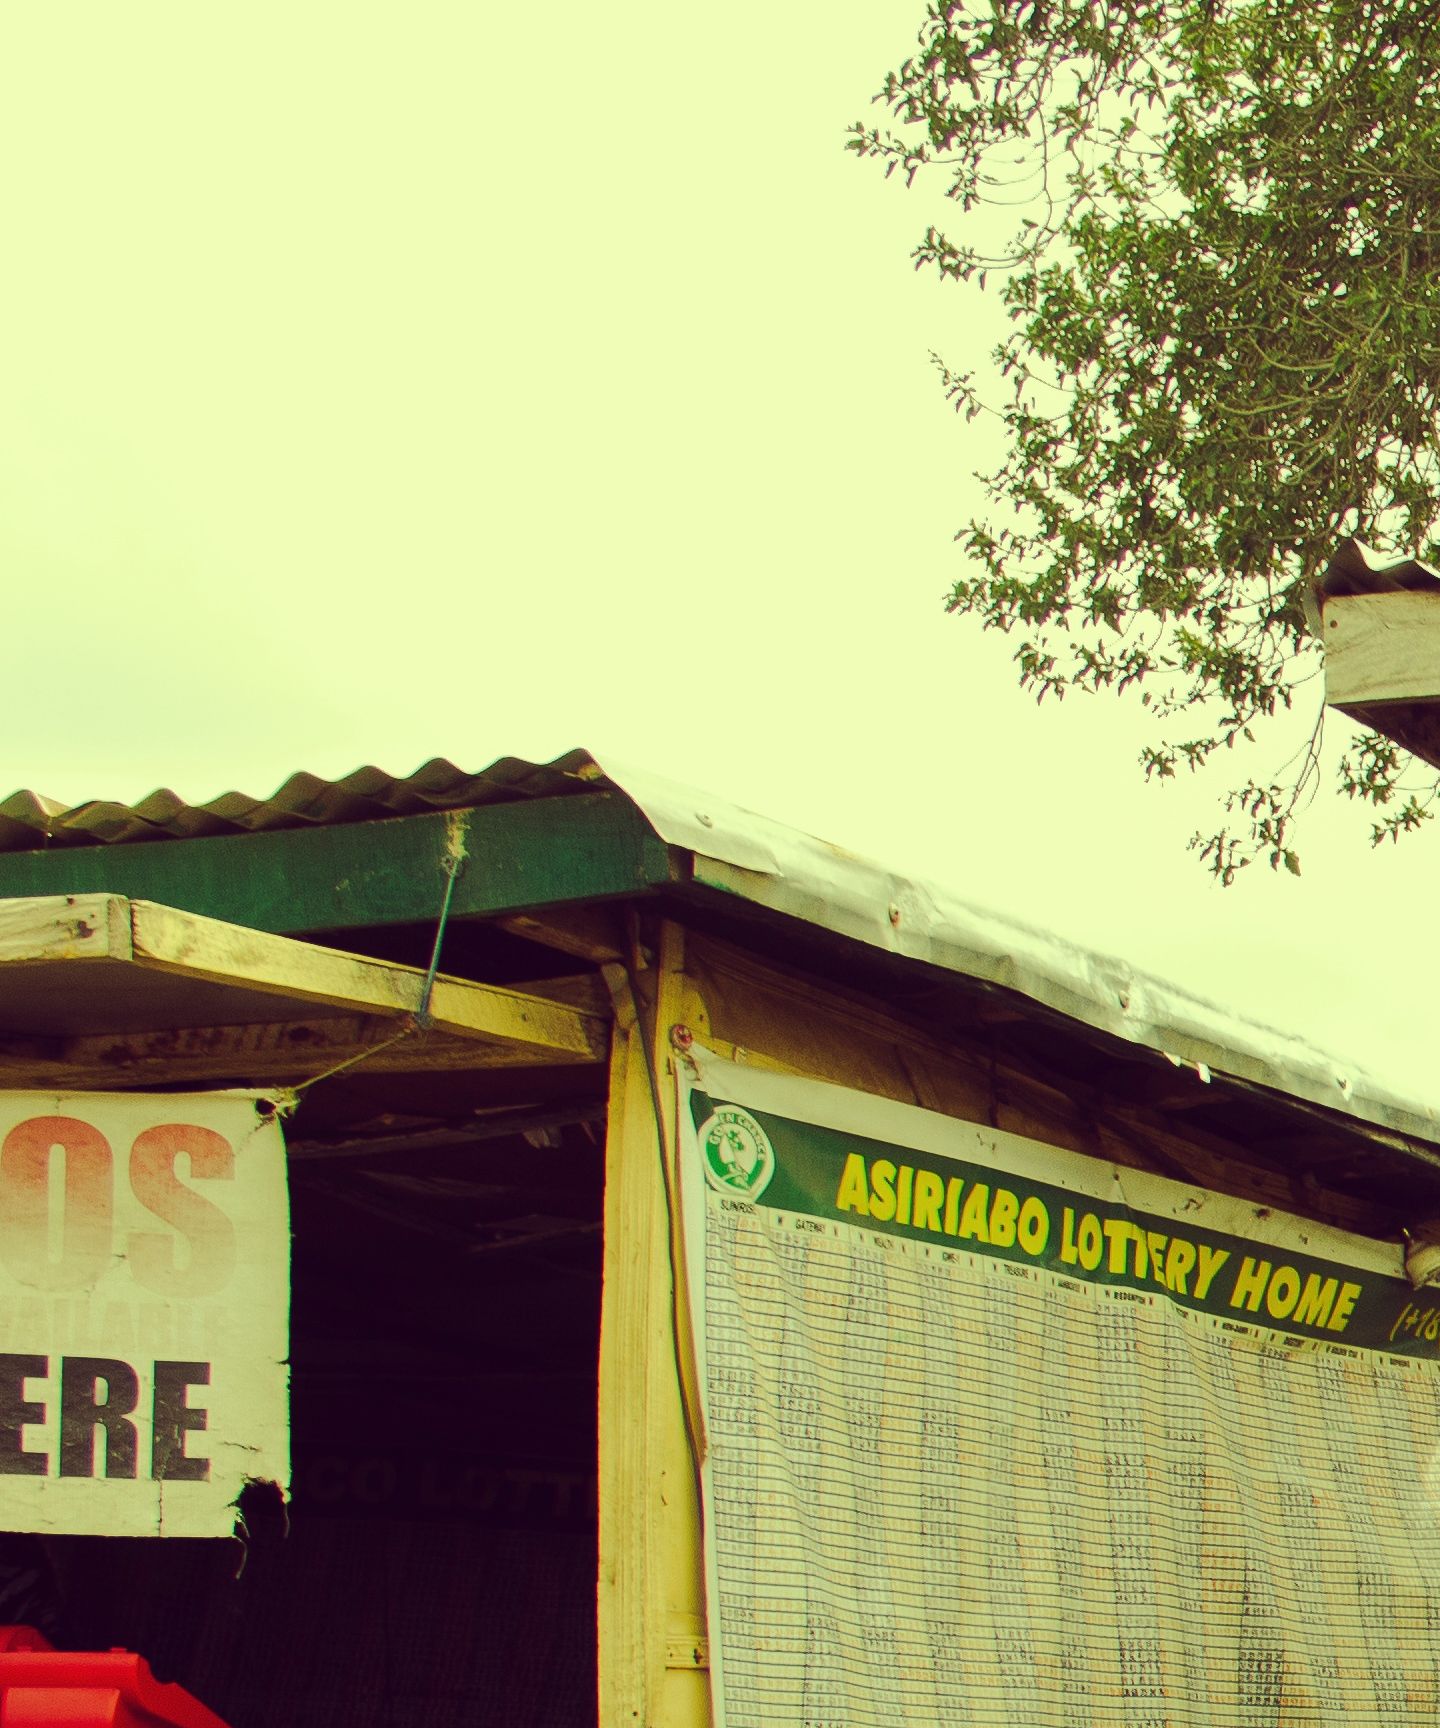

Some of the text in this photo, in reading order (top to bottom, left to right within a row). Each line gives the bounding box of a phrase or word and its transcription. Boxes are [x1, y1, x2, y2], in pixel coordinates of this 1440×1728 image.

[838, 1153, 1049, 1256] ASIRIABO
[1060, 1206, 1231, 1300] LOTTERY
[1230, 1256, 1362, 1332] HOME
